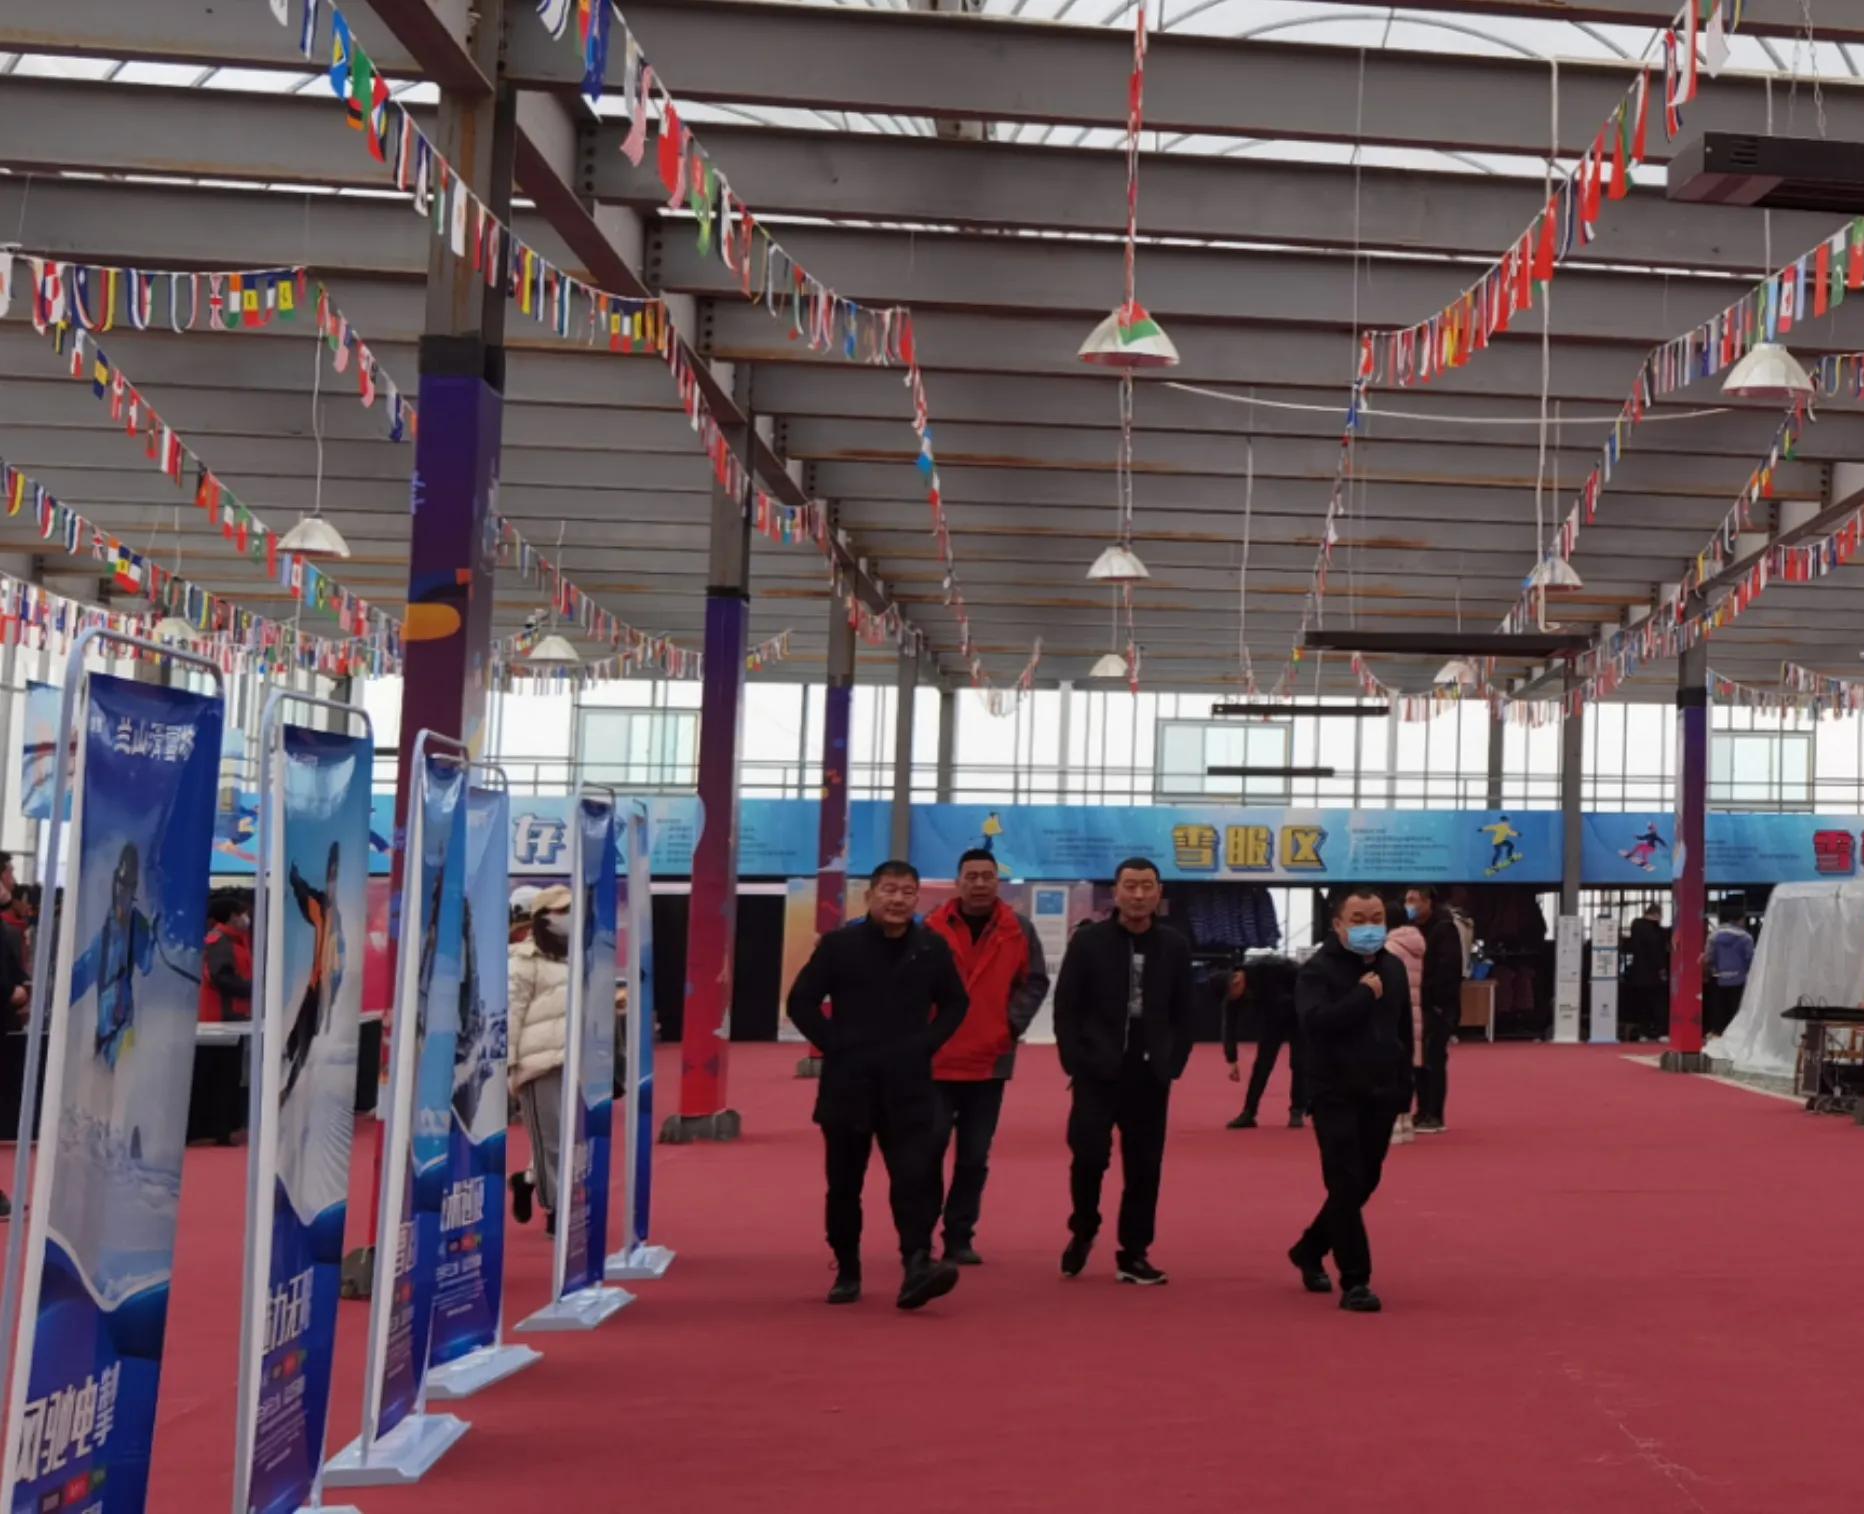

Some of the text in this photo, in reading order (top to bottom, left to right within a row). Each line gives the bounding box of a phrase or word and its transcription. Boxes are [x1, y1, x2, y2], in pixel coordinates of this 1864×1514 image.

[1172, 823, 1328, 872] 雪服区
[16, 1359, 121, 1484] 风驰电掣
